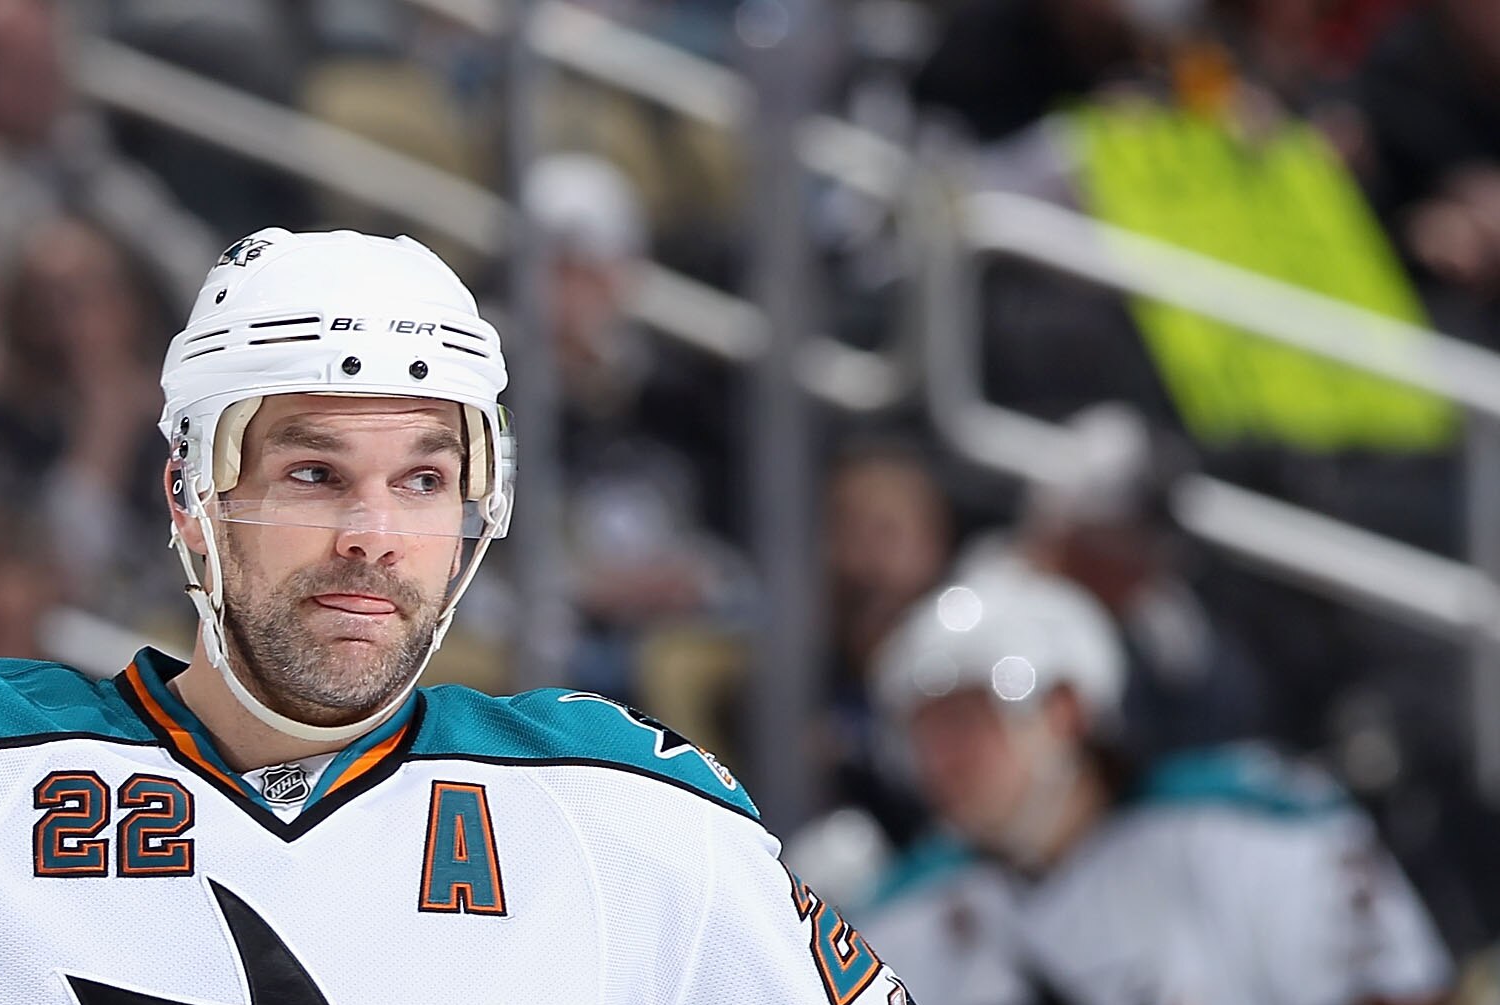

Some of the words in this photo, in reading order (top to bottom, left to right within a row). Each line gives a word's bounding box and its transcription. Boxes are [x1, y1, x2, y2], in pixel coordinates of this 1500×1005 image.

[329, 317, 436, 336] BAER
[269, 774, 301, 799] NHL
[33, 770, 195, 878] 22
[418, 780, 507, 916] A
